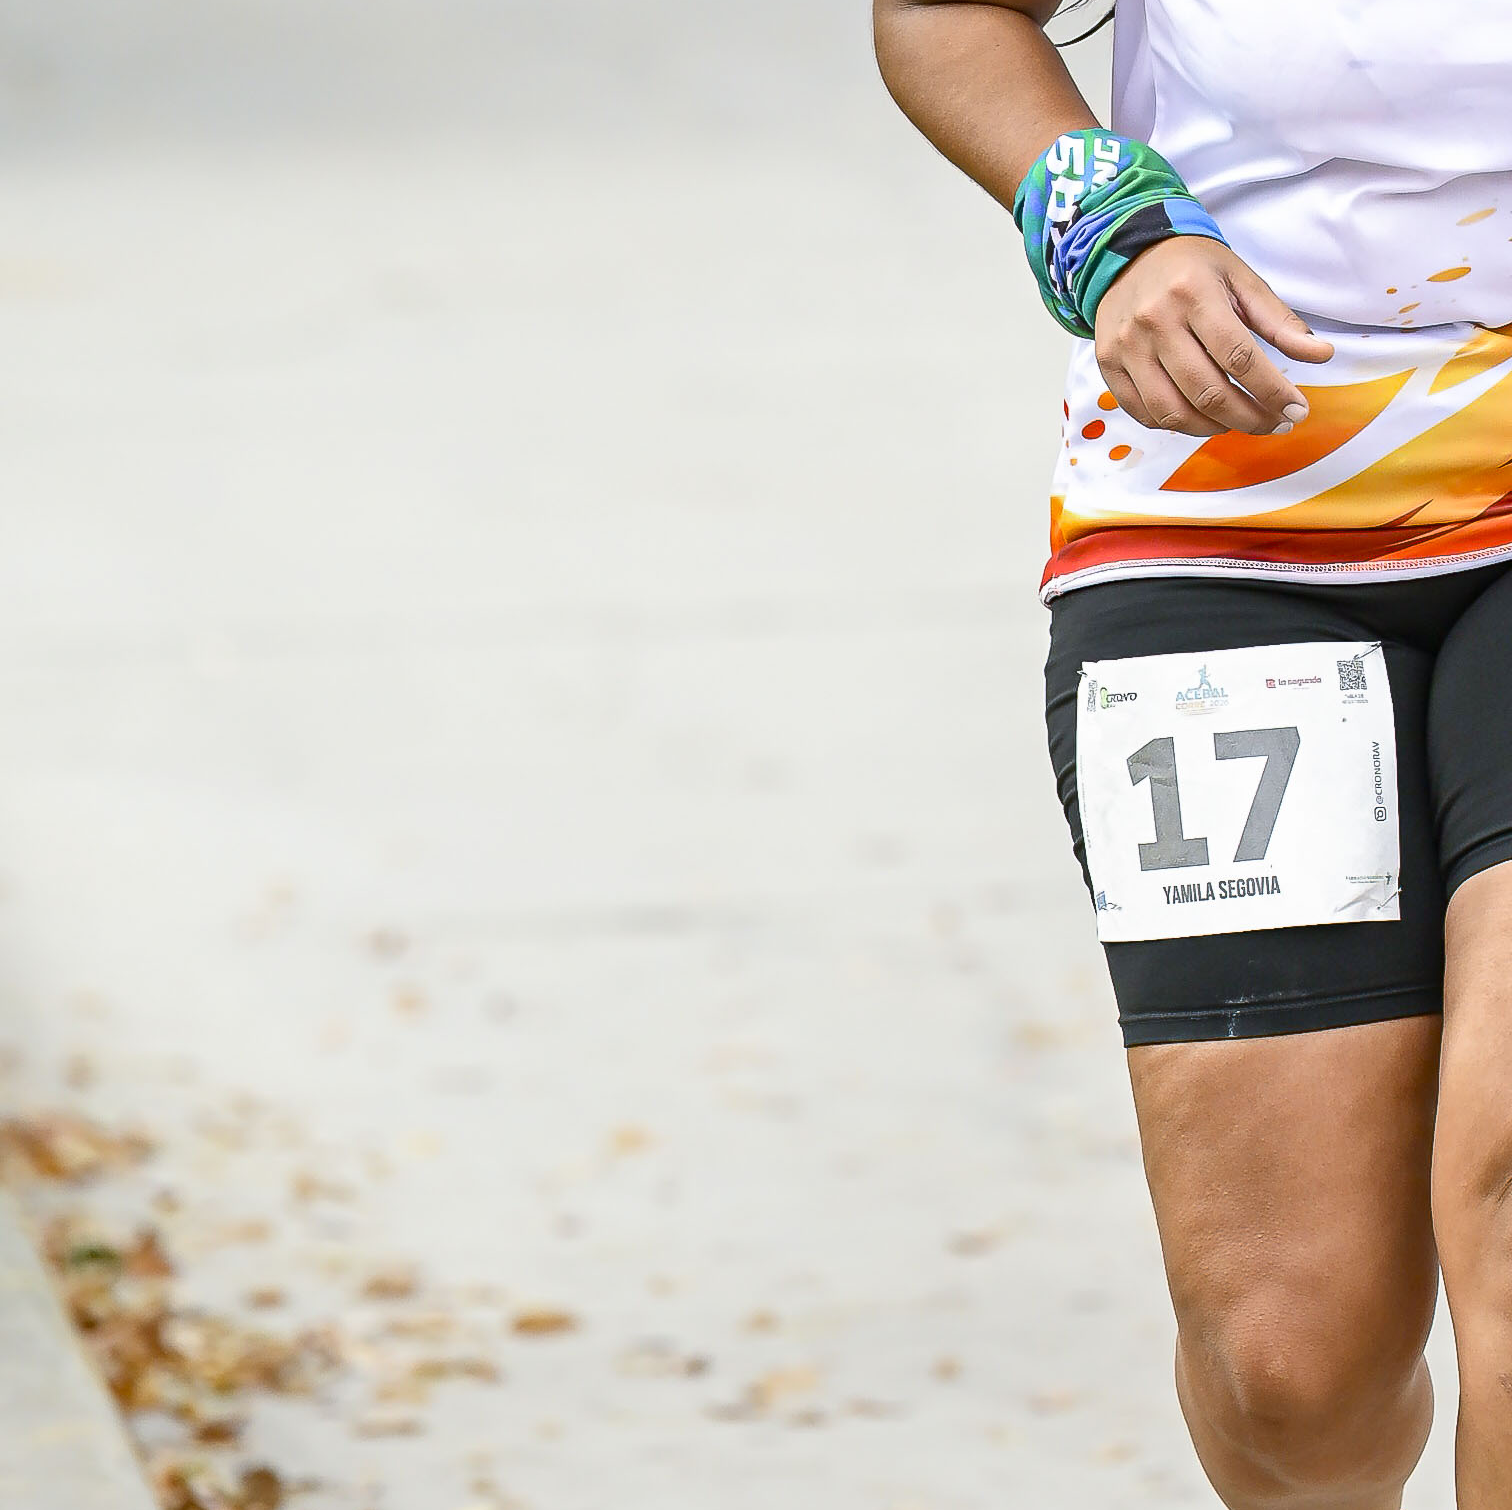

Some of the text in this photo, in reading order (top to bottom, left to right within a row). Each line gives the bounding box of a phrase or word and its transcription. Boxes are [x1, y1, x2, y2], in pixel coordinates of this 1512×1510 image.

[1175, 687, 1229, 702] ACEBAL
[1126, 726, 1301, 872] 17
[1162, 875, 1281, 905] YAMILA SEGOVIA
